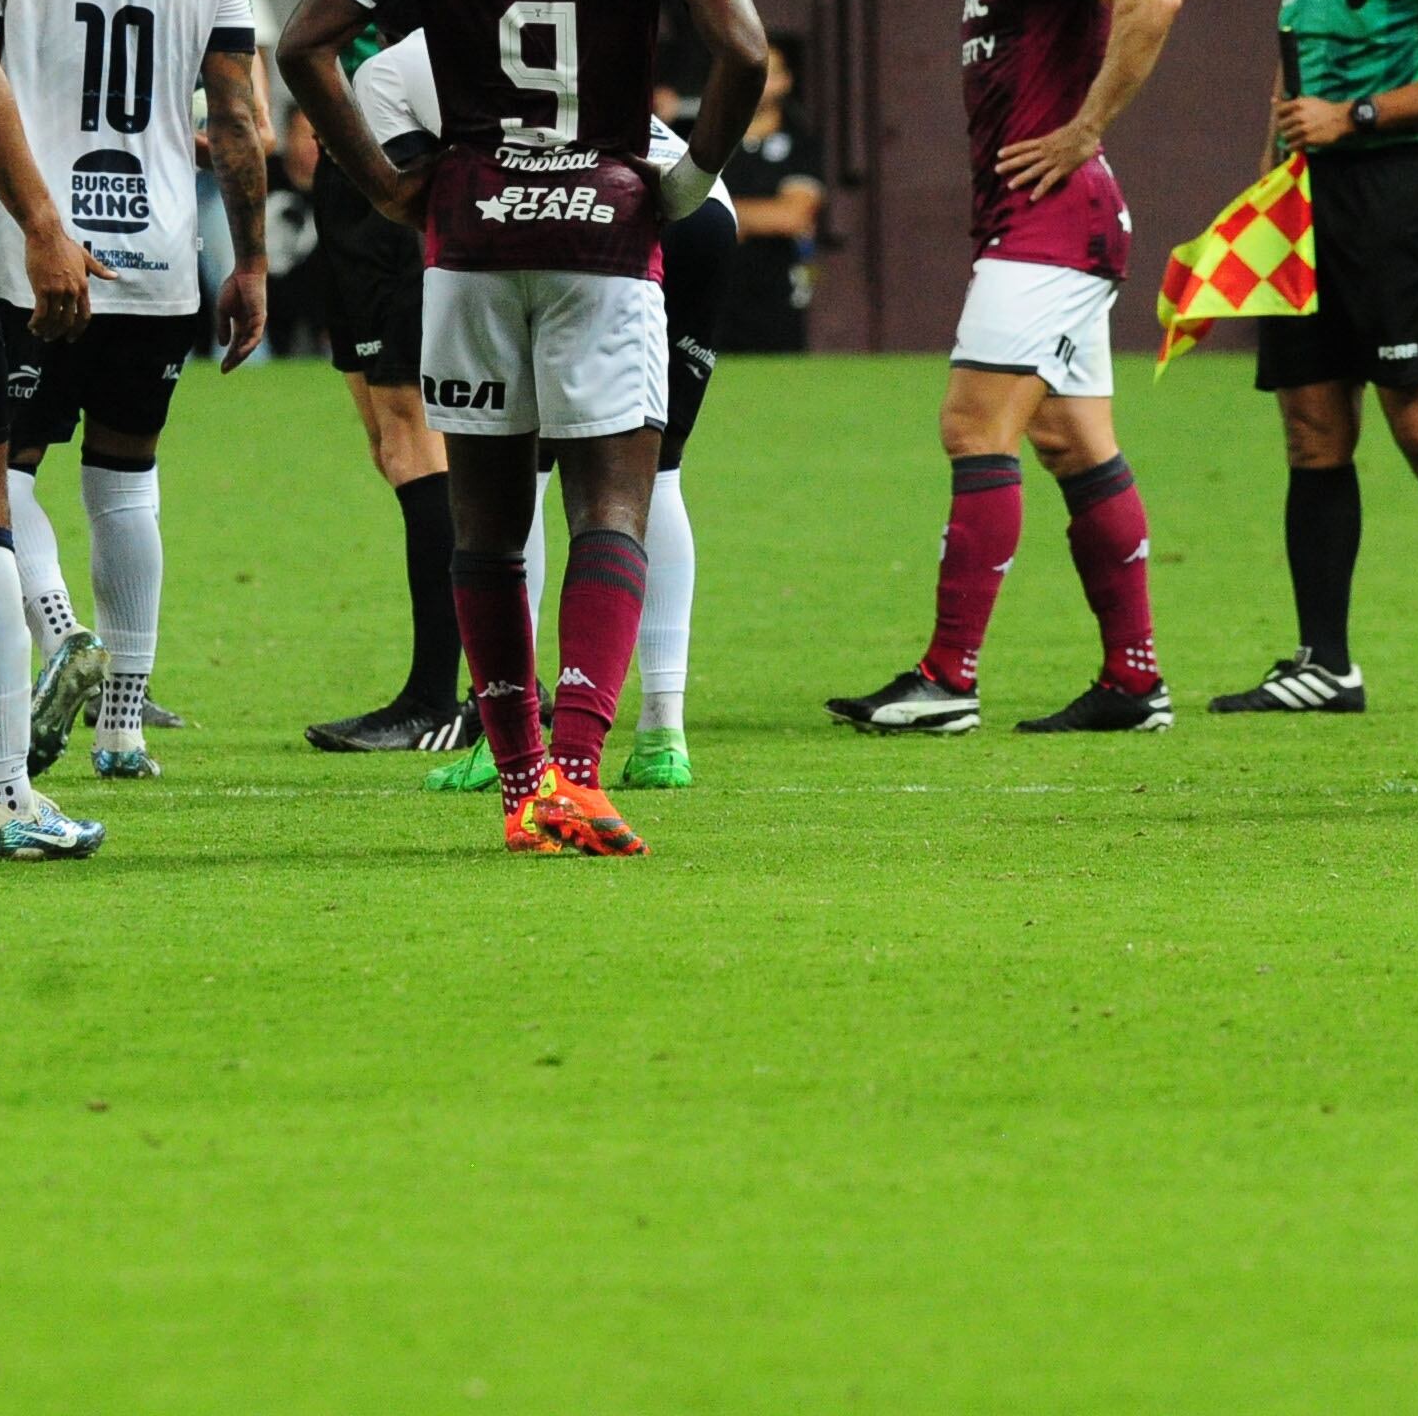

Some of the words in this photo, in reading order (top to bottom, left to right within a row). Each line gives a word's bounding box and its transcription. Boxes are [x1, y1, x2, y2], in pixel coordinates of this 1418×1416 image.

[75, 1, 155, 135] 10
[499, 1, 579, 147] 9
[495, 146, 599, 172] Tropical
[72, 174, 148, 195] BURGER
[499, 186, 597, 205] STAR
[72, 193, 150, 219] KING
[512, 202, 615, 224] CARS
[93, 248, 145, 261] UNIVERSIDAD
[422, 374, 506, 410] RCA
